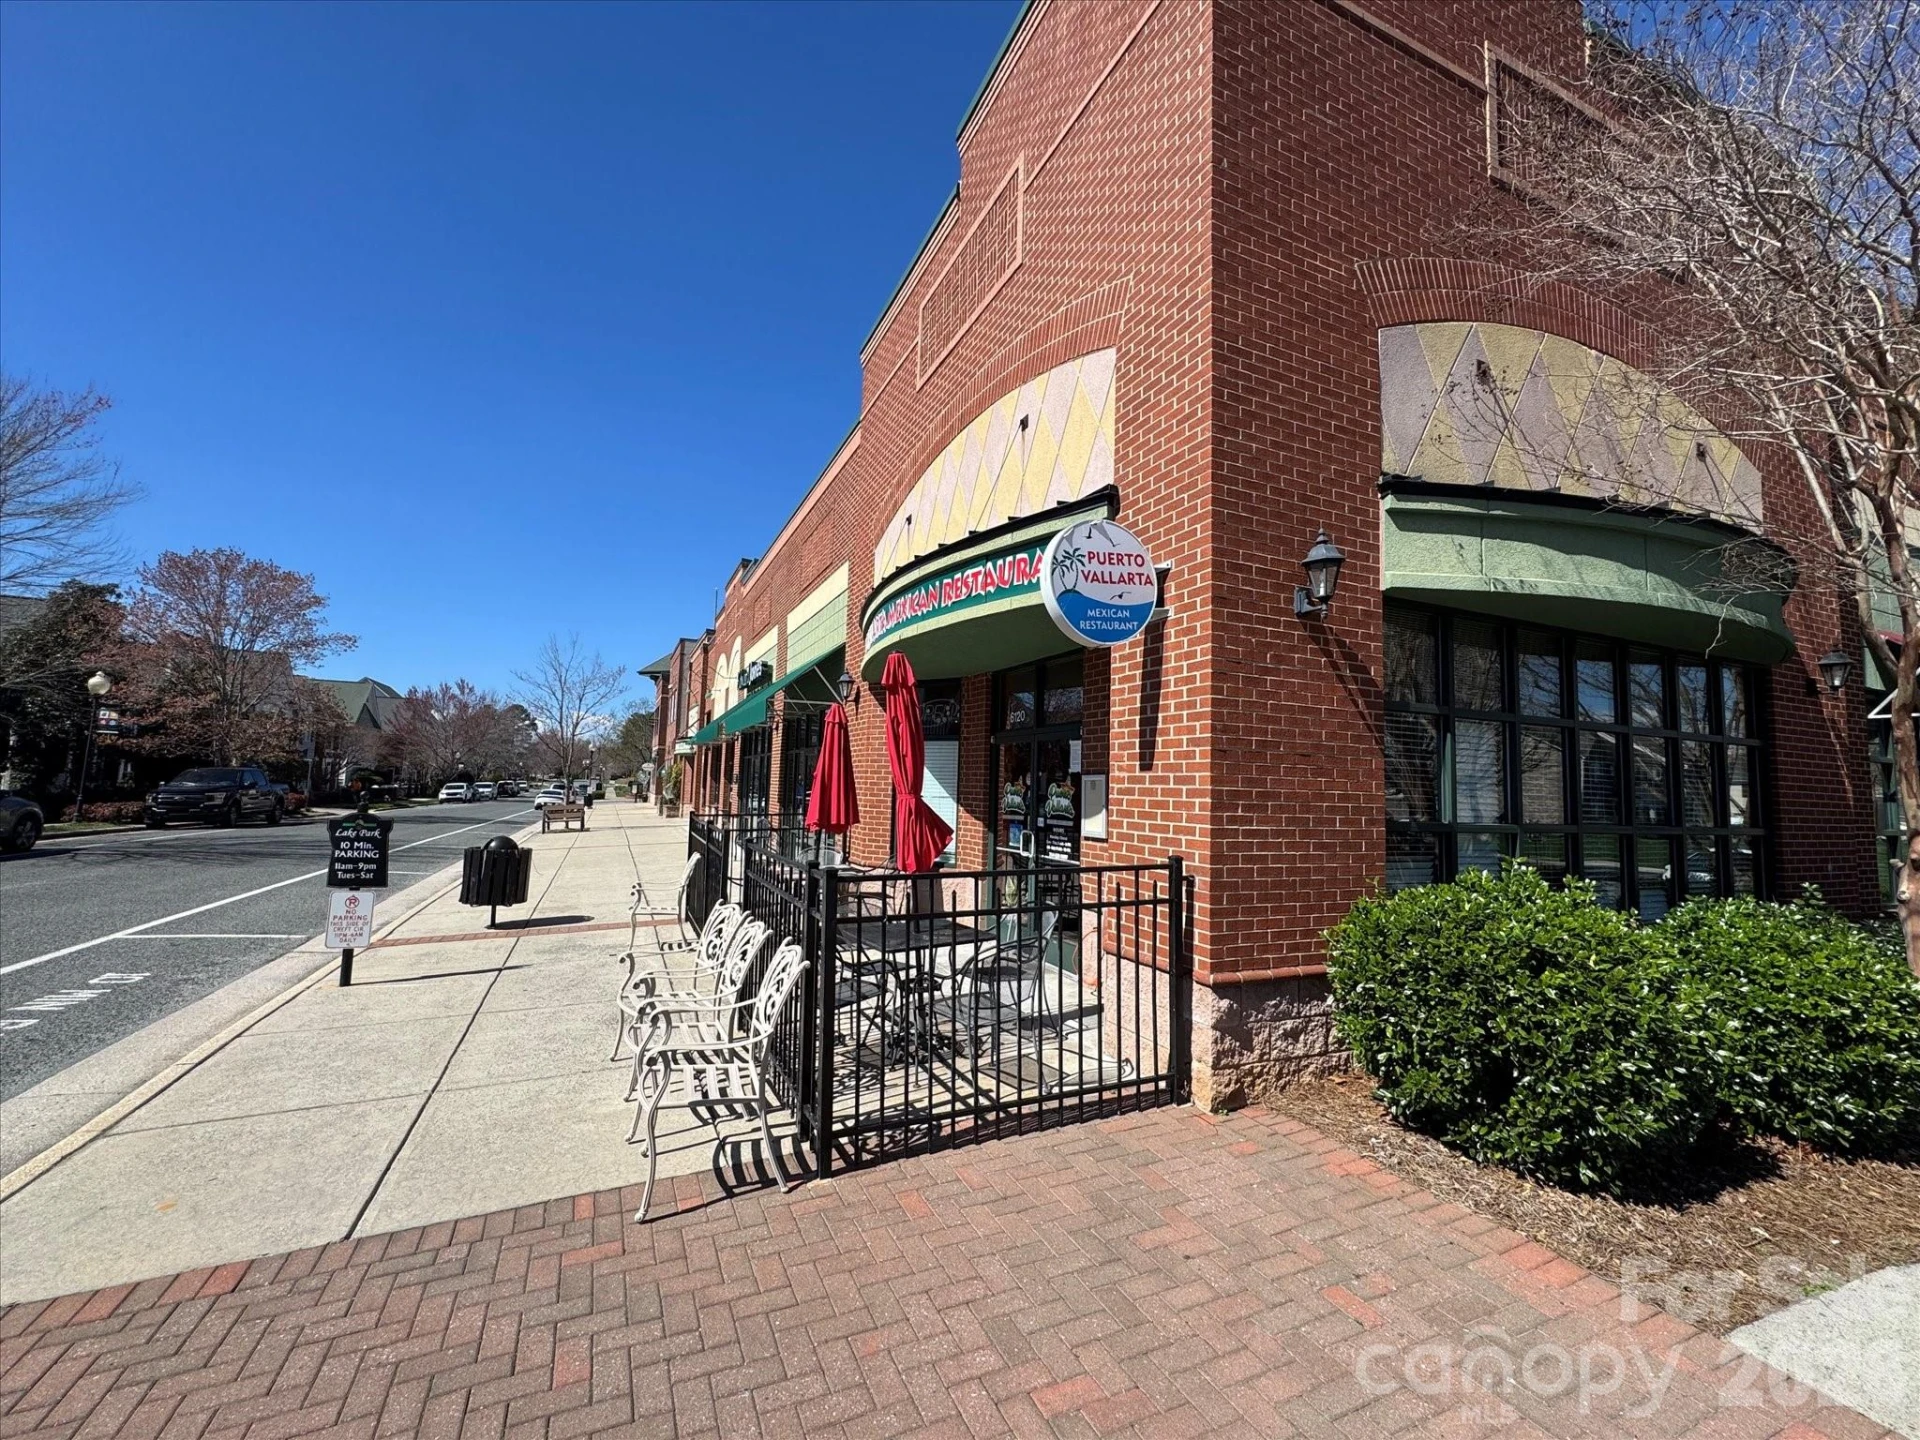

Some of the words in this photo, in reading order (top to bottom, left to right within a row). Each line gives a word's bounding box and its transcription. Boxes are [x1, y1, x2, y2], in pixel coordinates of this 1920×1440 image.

[1087, 551, 1145, 568] PUERTO
[1081, 570, 1154, 587] VALLARTA
[887, 581, 940, 629] MEXICAN
[941, 548, 1043, 607] RESTAURA
[1087, 608, 1130, 619] MEXICAN
[1079, 621, 1139, 632] RESTAURANT
[1010, 710, 1025, 723] 6120
[335, 829, 358, 839] Lake
[359, 829, 382, 839] Park
[340, 841, 351, 849] 10
[353, 841, 374, 849] Min.
[334, 850, 379, 858] PARKING
